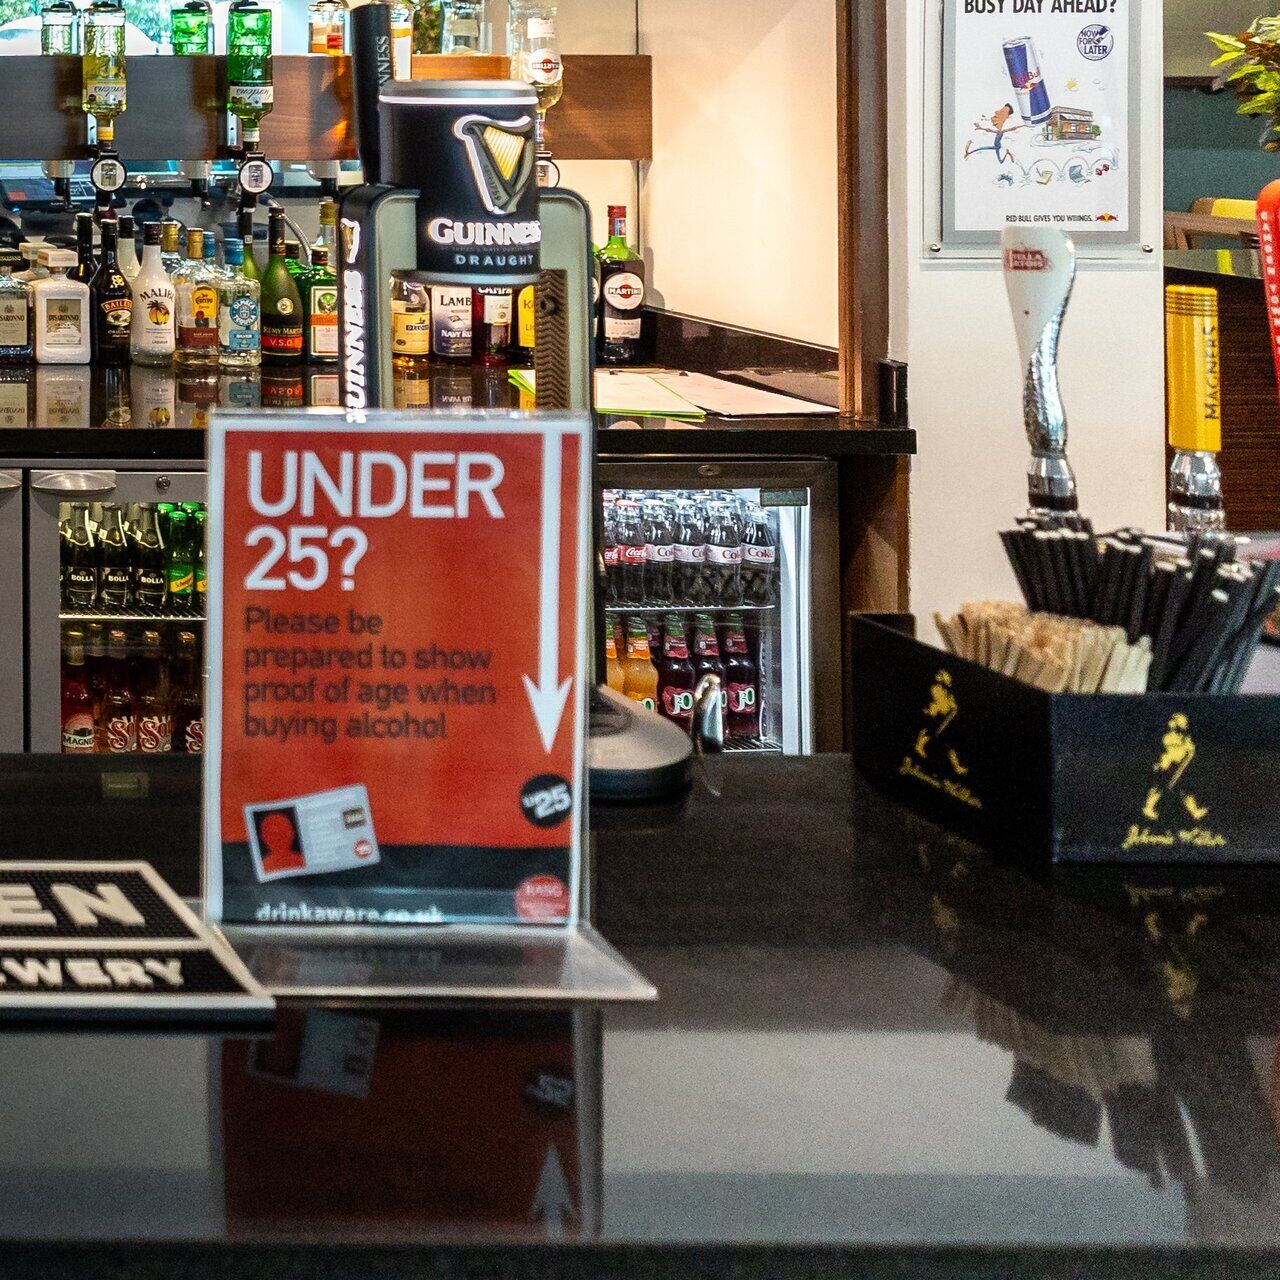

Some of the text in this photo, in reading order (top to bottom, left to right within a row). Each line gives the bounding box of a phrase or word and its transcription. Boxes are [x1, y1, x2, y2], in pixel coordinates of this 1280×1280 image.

[1084, 45, 1107, 55] LATER
[428, 218, 541, 245] GUINNESS
[455, 254, 534, 267] DRAUGHT
[1205, 325, 1218, 420] MAGNERS
[247, 451, 505, 519] UNDER
[245, 525, 368, 591] 25?
[245, 607, 383, 633] Please be
[244, 644, 492, 675] prepared to show
[244, 678, 496, 711] proof of age when
[244, 712, 448, 744] buying alcohol
